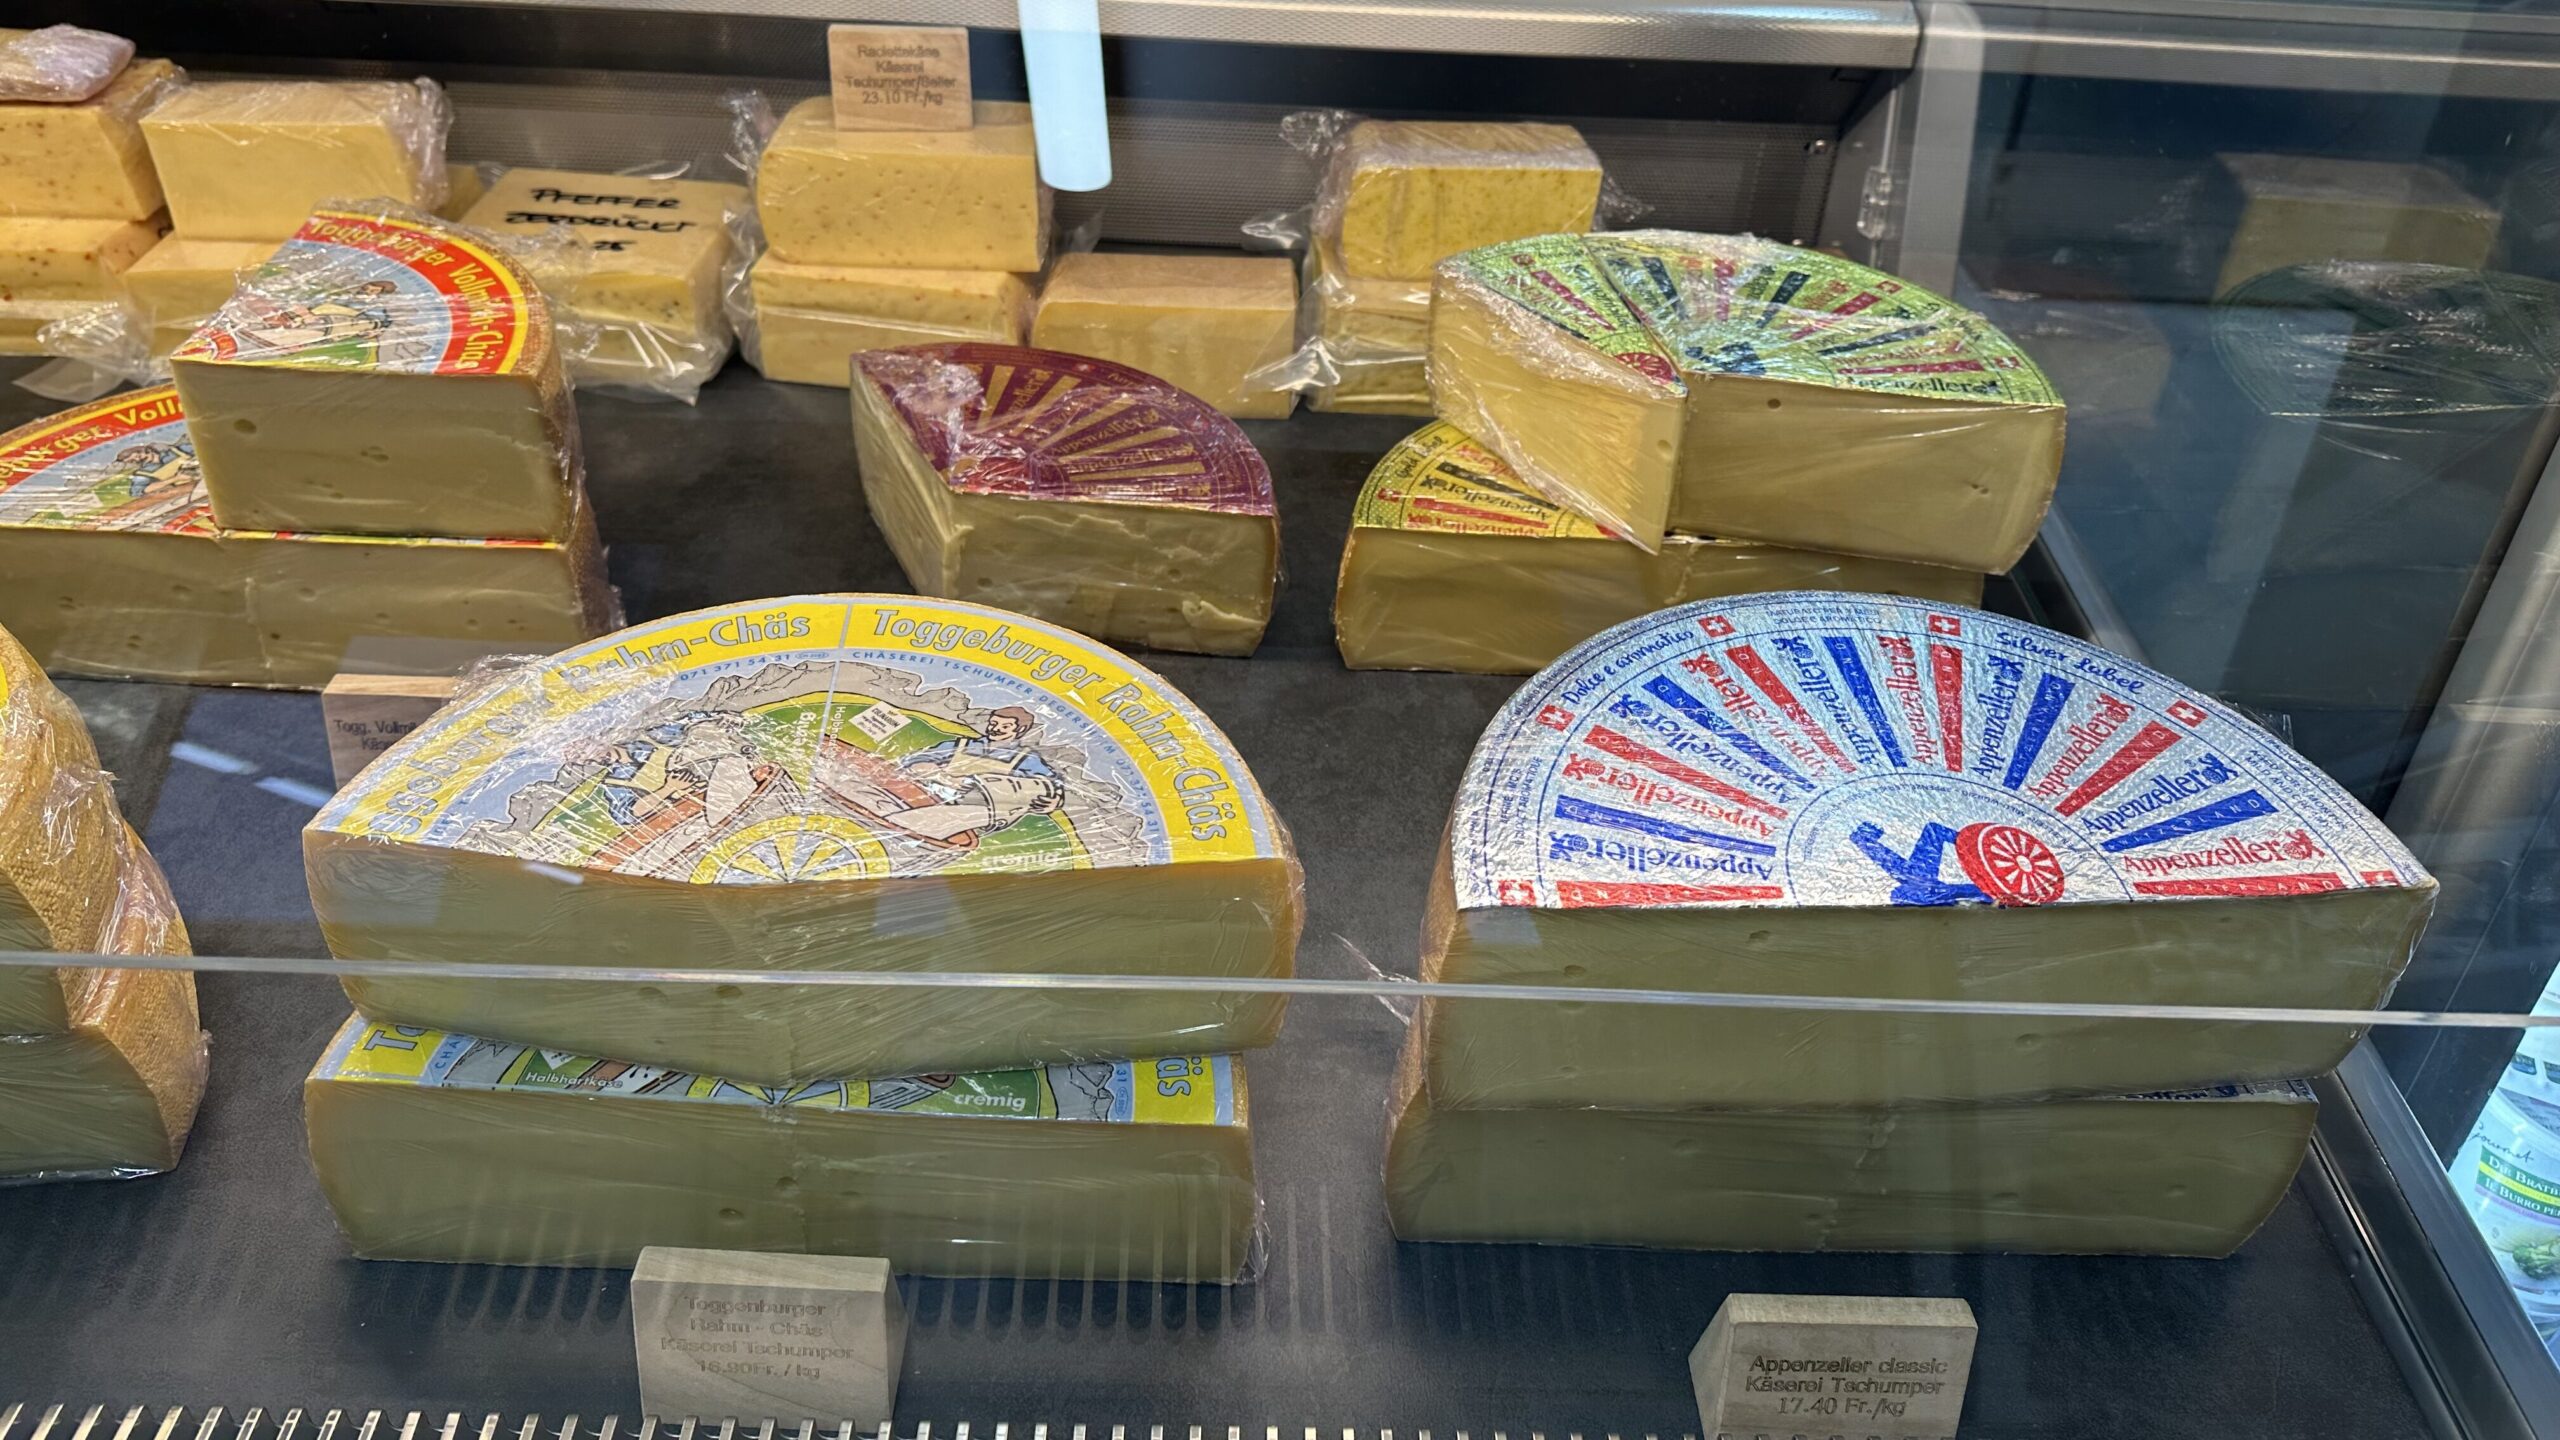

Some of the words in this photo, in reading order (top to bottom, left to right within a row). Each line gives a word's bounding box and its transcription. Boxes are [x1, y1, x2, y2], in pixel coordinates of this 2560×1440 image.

[862, 91, 900, 105] 23.10
[530, 186, 660, 210] PFEFFER
[680, 667, 707, 682] 071
[713, 661, 740, 674] 371
[748, 656, 767, 668] 54
[774, 653, 790, 662] 31
[1996, 631, 2070, 663] Silver
[2073, 656, 2145, 695] Label
[943, 661, 1034, 695] TSCHUMPER
[1560, 672, 1606, 705] Dolce
[873, 609, 1107, 690] Toggeburger
[1097, 682, 1237, 842] Rahm-Chäs
[1886, 656, 1939, 767] Appenzeller
[1971, 674, 2020, 780] Appenzeller
[2027, 712, 2119, 801] Appenzeller
[1598, 764, 1778, 838] Appenzeller
[2079, 770, 2204, 834] Appenzeller
[1588, 838, 1774, 881] Appenzeller
[2123, 835, 2286, 877] Appenzeller
[524, 1071, 623, 1089] Halbhartkäse
[953, 1092, 1026, 1111] cremig
[2499, 1184, 2541, 1212] BURRO
[684, 1297, 827, 1317] Toggenburger
[690, 1318, 750, 1334] Rahm
[769, 1321, 824, 1338] Chäs
[661, 1337, 738, 1354] Käserei
[742, 1341, 855, 1361] Tschumper
[1749, 1355, 1873, 1375] Appenzeller
[1877, 1357, 1948, 1374] classic
[1745, 1375, 1824, 1393] Käserei
[1830, 1376, 1945, 1398] Tschumper
[1776, 1397, 1839, 1415] 17.40
[1844, 1397, 1907, 1420] Fr./kg
